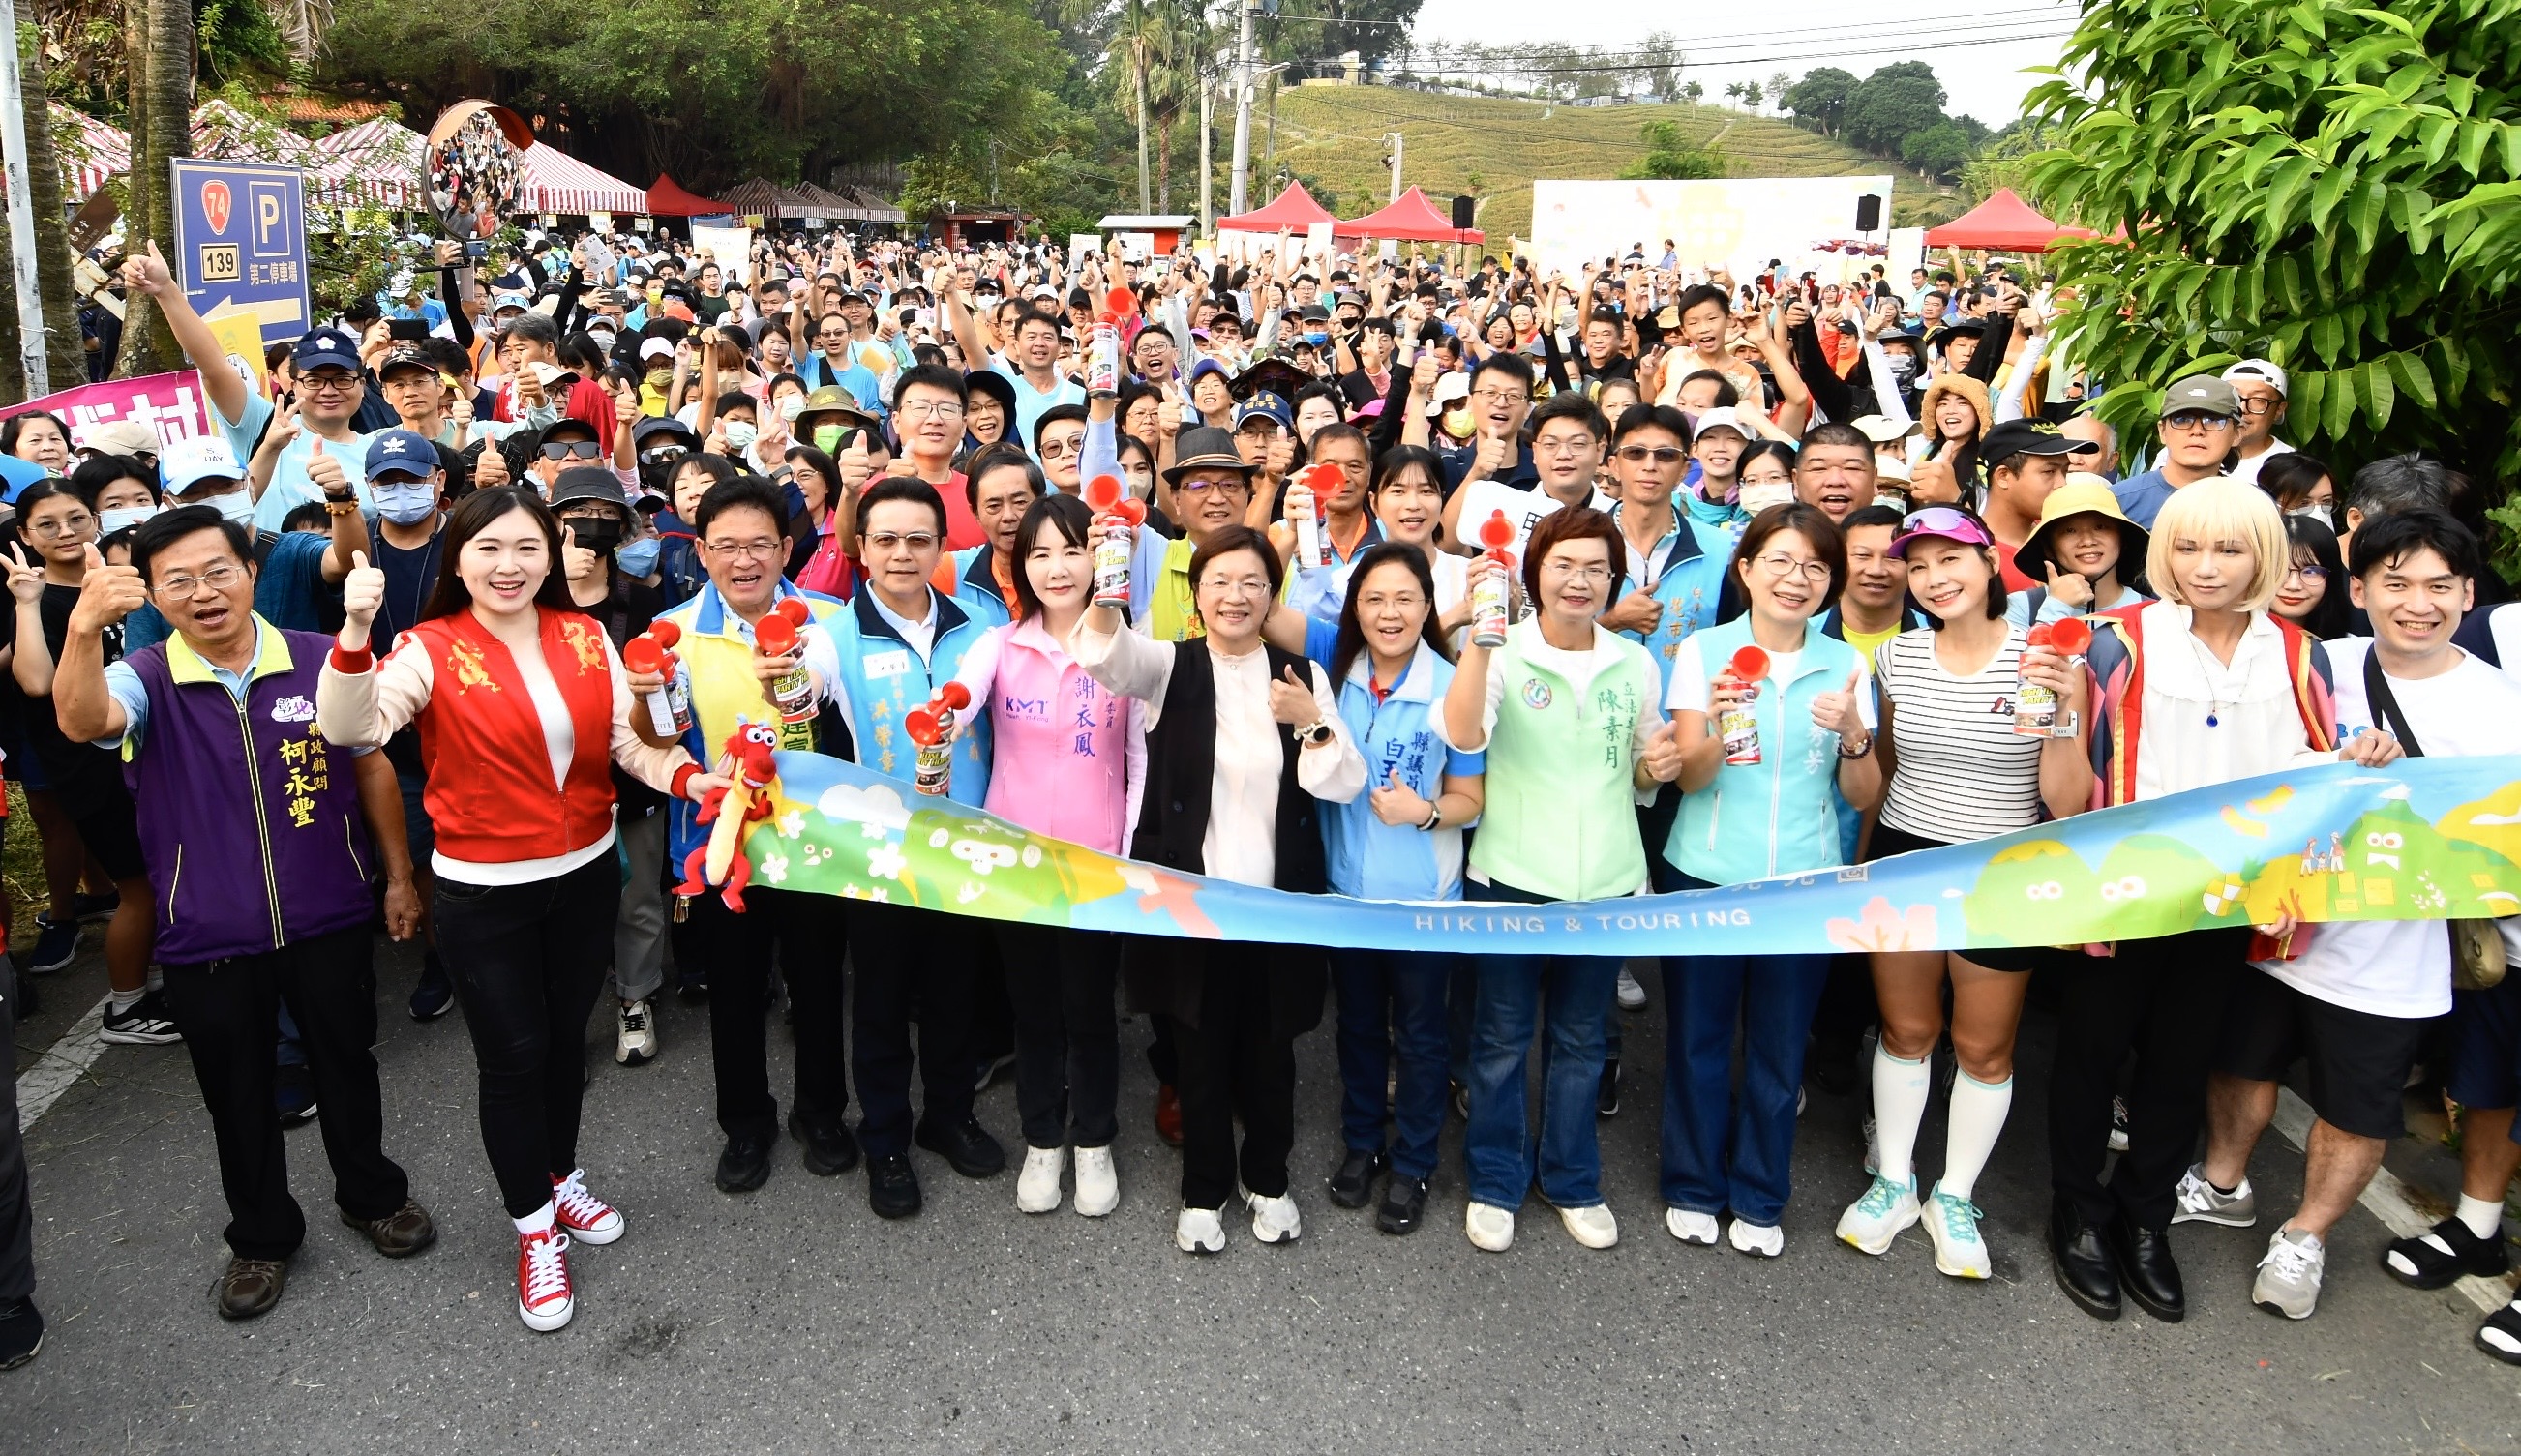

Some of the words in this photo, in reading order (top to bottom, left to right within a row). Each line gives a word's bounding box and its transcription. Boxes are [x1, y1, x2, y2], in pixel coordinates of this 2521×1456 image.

[207, 193, 226, 218] 74
[258, 194, 280, 244] P
[206, 252, 234, 273] 139
[249, 261, 298, 286] 第二停車場
[1006, 696, 1048, 715] KMT
[1073, 675, 1097, 758] 謝衣鳳
[1597, 688, 1624, 769] 陳素月
[308, 722, 328, 790] 縣政顧問
[1380, 737, 1406, 788] 白玉
[279, 738, 316, 828] 柯永豐
[1415, 914, 1546, 934] HIKING
[1565, 917, 1582, 932] &
[1597, 908, 1752, 932] TOURING
